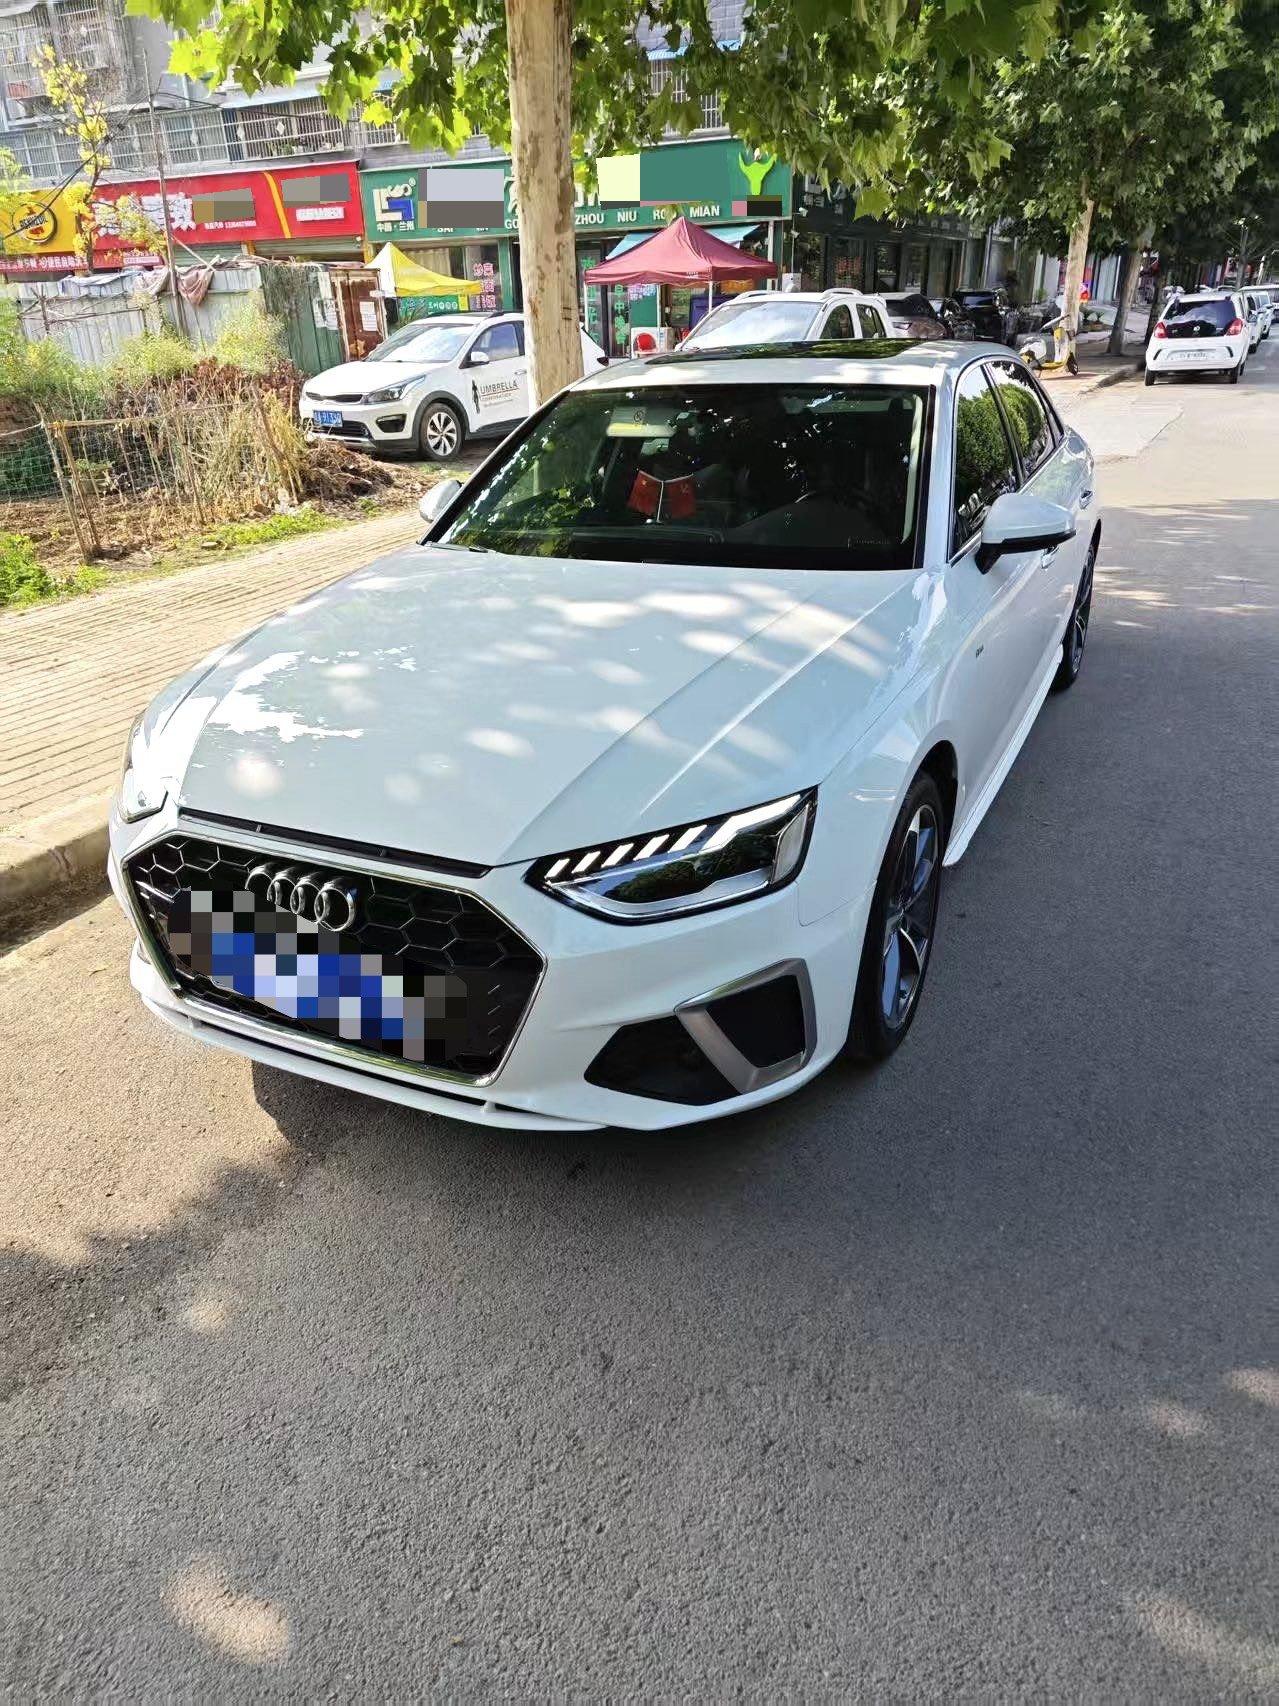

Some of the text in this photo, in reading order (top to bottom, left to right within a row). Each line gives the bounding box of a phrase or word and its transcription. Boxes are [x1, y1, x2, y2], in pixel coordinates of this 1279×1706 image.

[505, 205, 720, 229] GO ZHOU NIU RO MIAN
[480, 380, 518, 394] UMBRELLA
